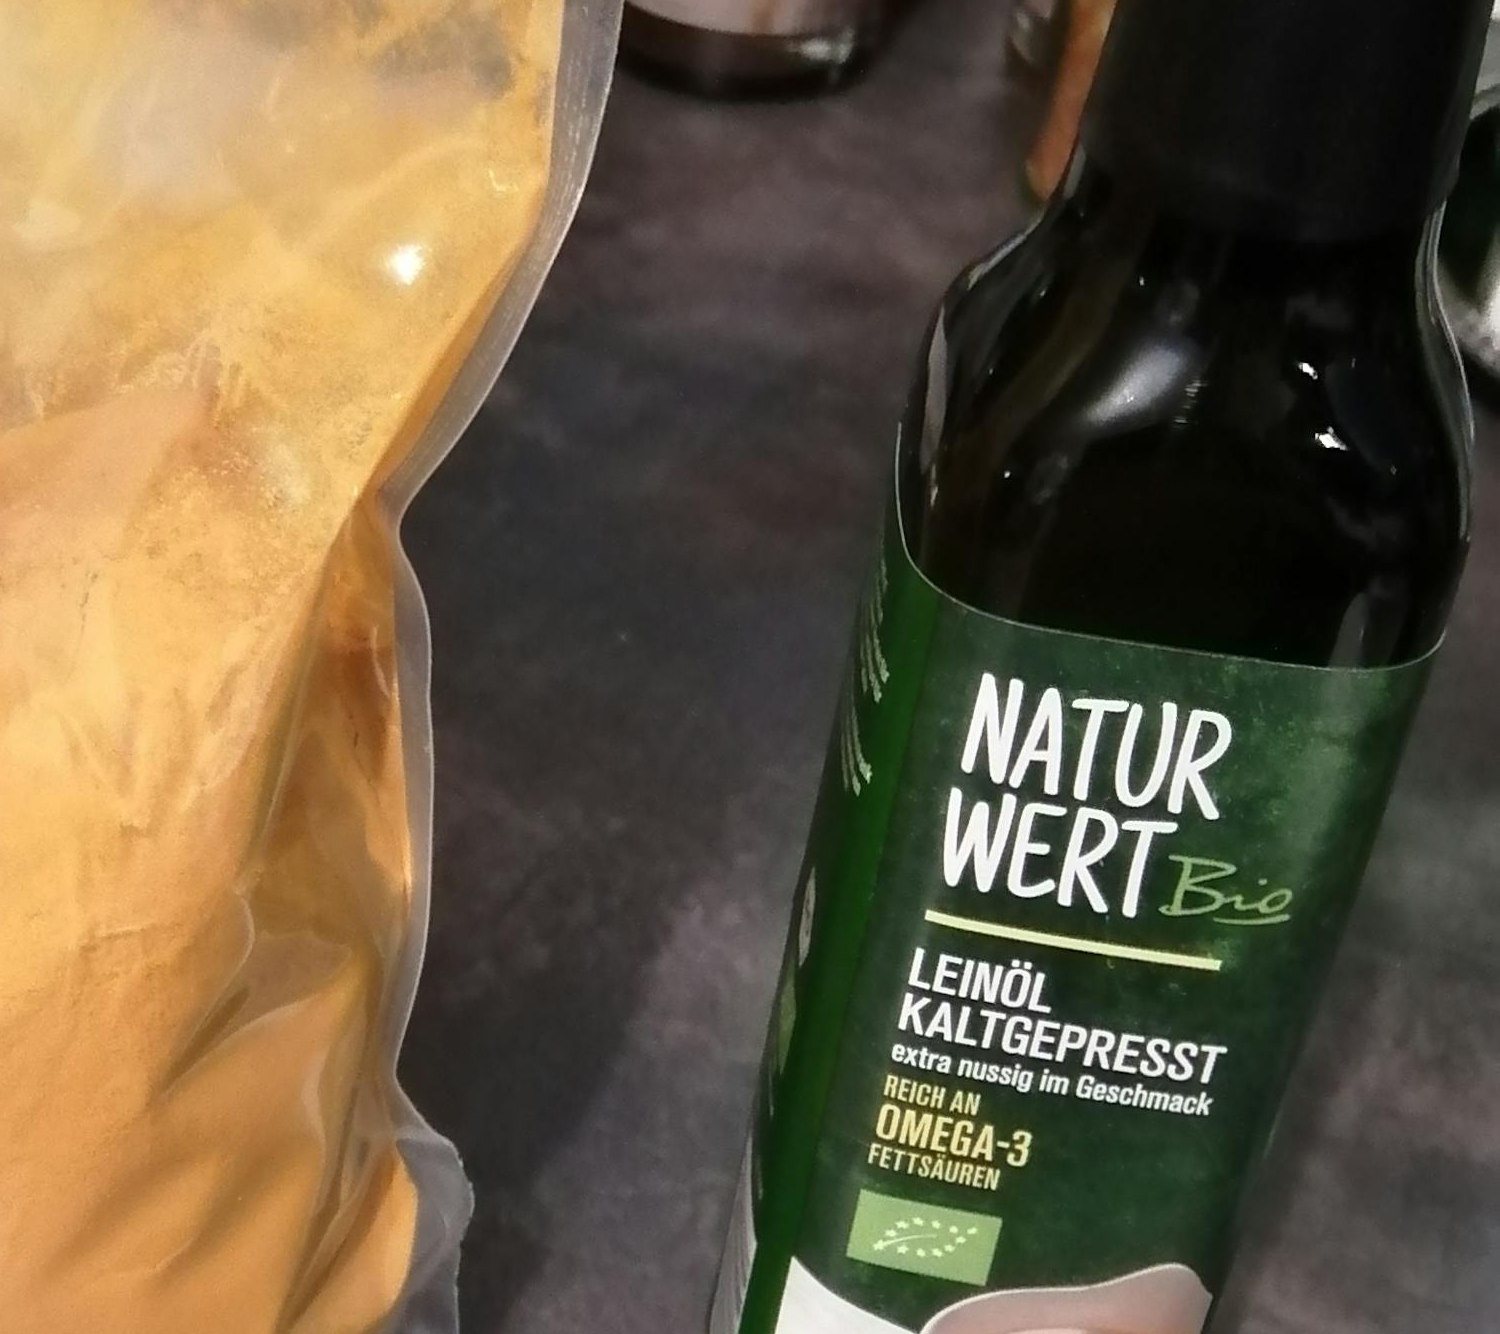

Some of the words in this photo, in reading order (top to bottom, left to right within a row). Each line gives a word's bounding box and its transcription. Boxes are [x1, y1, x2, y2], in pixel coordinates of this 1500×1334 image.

[960, 671, 1233, 821] NATUR
[942, 786, 1178, 919] WERT
[1158, 854, 1294, 923] Bio
[907, 946, 1052, 1014] LEINÖL
[898, 993, 1228, 1085] KALTGEPRESST
[884, 1075, 946, 1106] REICH
[950, 1092, 981, 1116] AN
[891, 1042, 950, 1075] extra
[957, 1057, 1034, 1093] nussig
[1038, 1068, 1069, 1096] im
[1076, 1075, 1213, 1116] Geschmack
[867, 1143, 1001, 1191] FETTSÄUREN
[875, 1103, 1033, 1168] OMEGA-3
